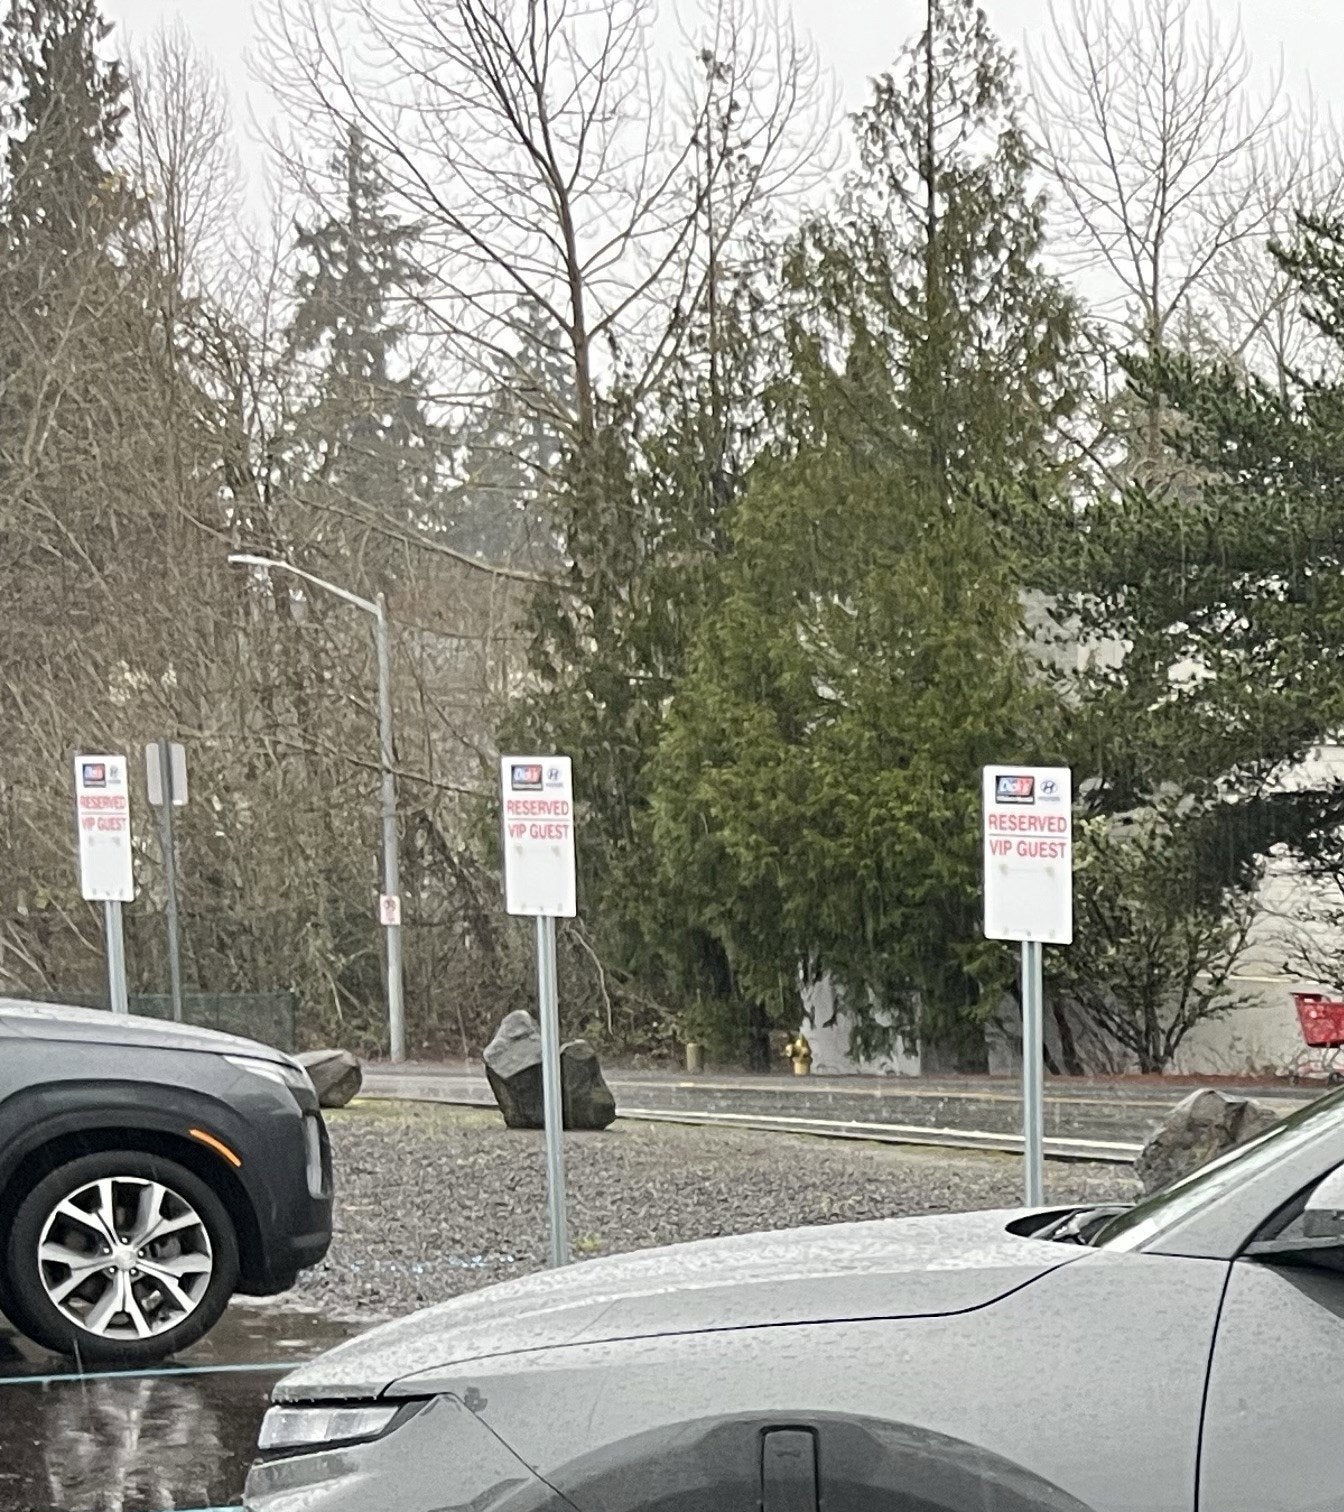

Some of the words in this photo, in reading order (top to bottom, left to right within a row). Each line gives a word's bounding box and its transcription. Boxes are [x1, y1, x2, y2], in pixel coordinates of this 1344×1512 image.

[507, 800, 570, 815] RESERVED
[508, 823, 527, 839] VIP
[530, 823, 570, 840] GUEST
[988, 814, 1068, 833] RESERVED
[989, 839, 1012, 856] VIP
[1016, 840, 1067, 859] GUEST
